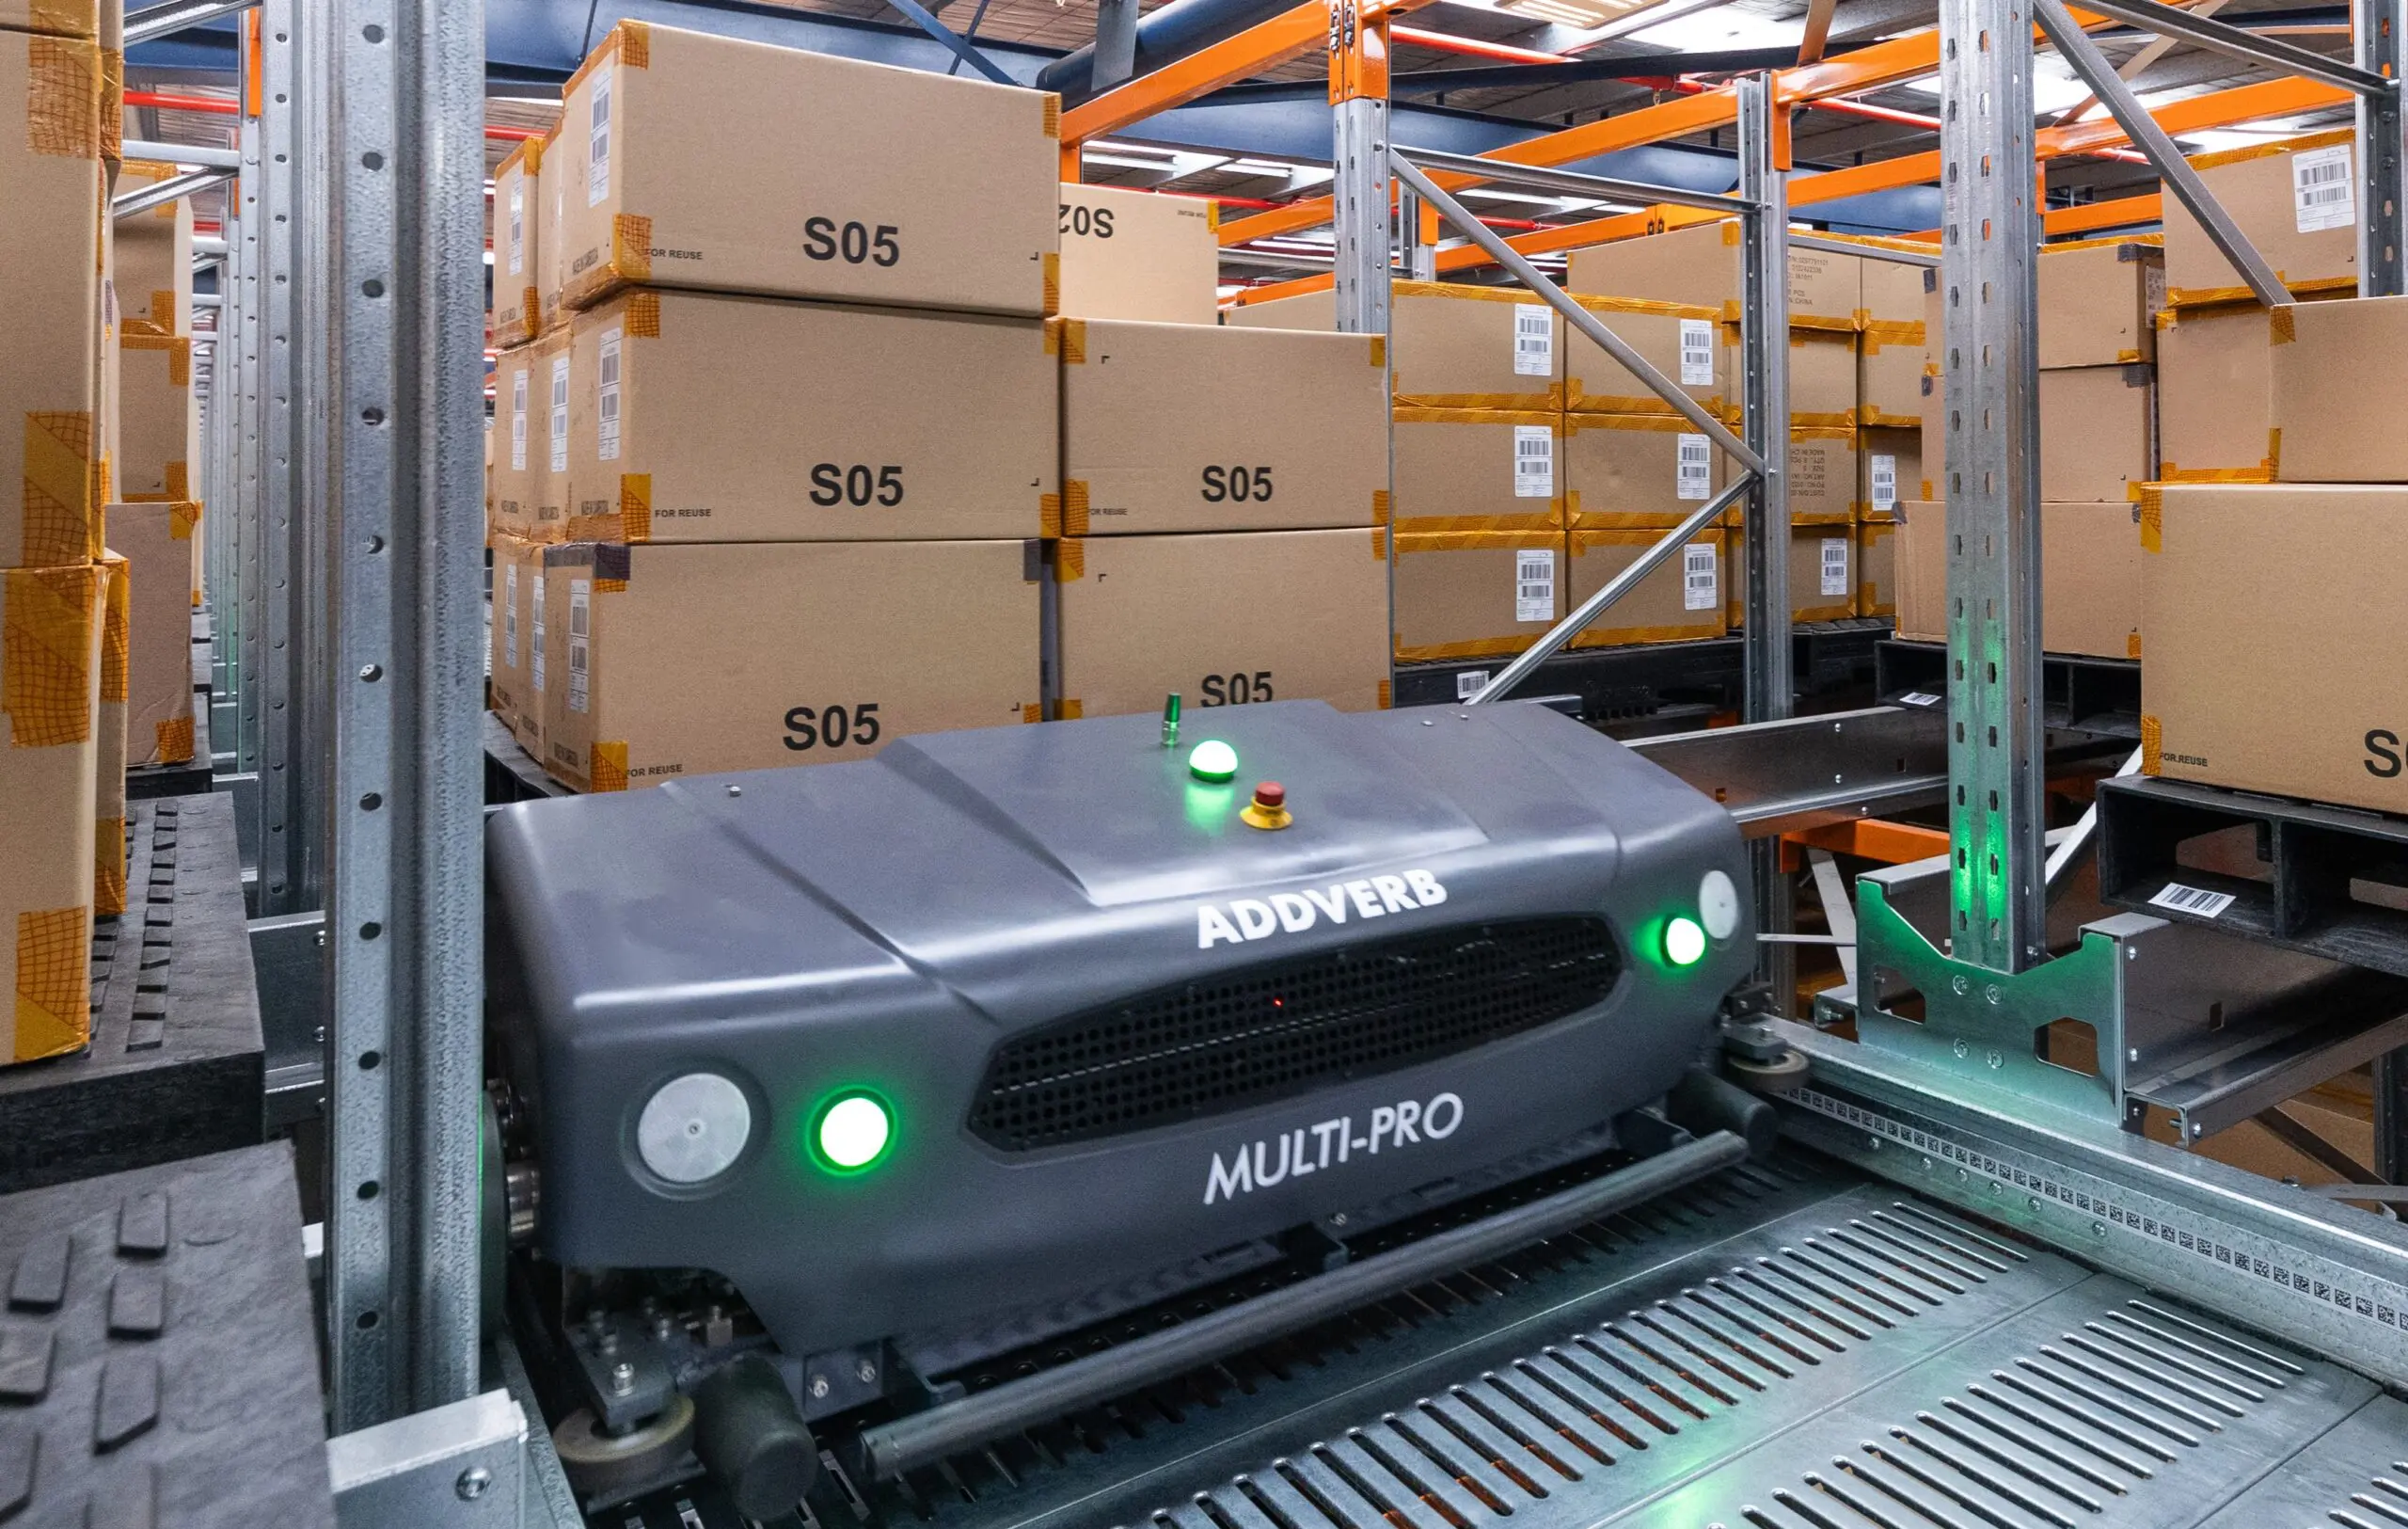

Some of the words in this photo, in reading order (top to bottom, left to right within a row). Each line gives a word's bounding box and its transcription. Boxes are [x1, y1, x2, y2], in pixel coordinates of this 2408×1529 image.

[668, 249, 705, 261] REUSE
[802, 216, 900, 268] S05
[808, 462, 904, 507] S05
[1201, 465, 1274, 502] S05
[654, 509, 676, 518] FOR
[677, 508, 712, 518] REUSE
[1200, 671, 1274, 709] S05
[782, 703, 880, 752] S05
[647, 763, 685, 776] REUSE
[2178, 754, 2209, 768] REUSE
[2363, 728, 2408, 779] S
[1197, 868, 1449, 950] ADDVERB
[1202, 1091, 1465, 1206] MULTI-PRO
